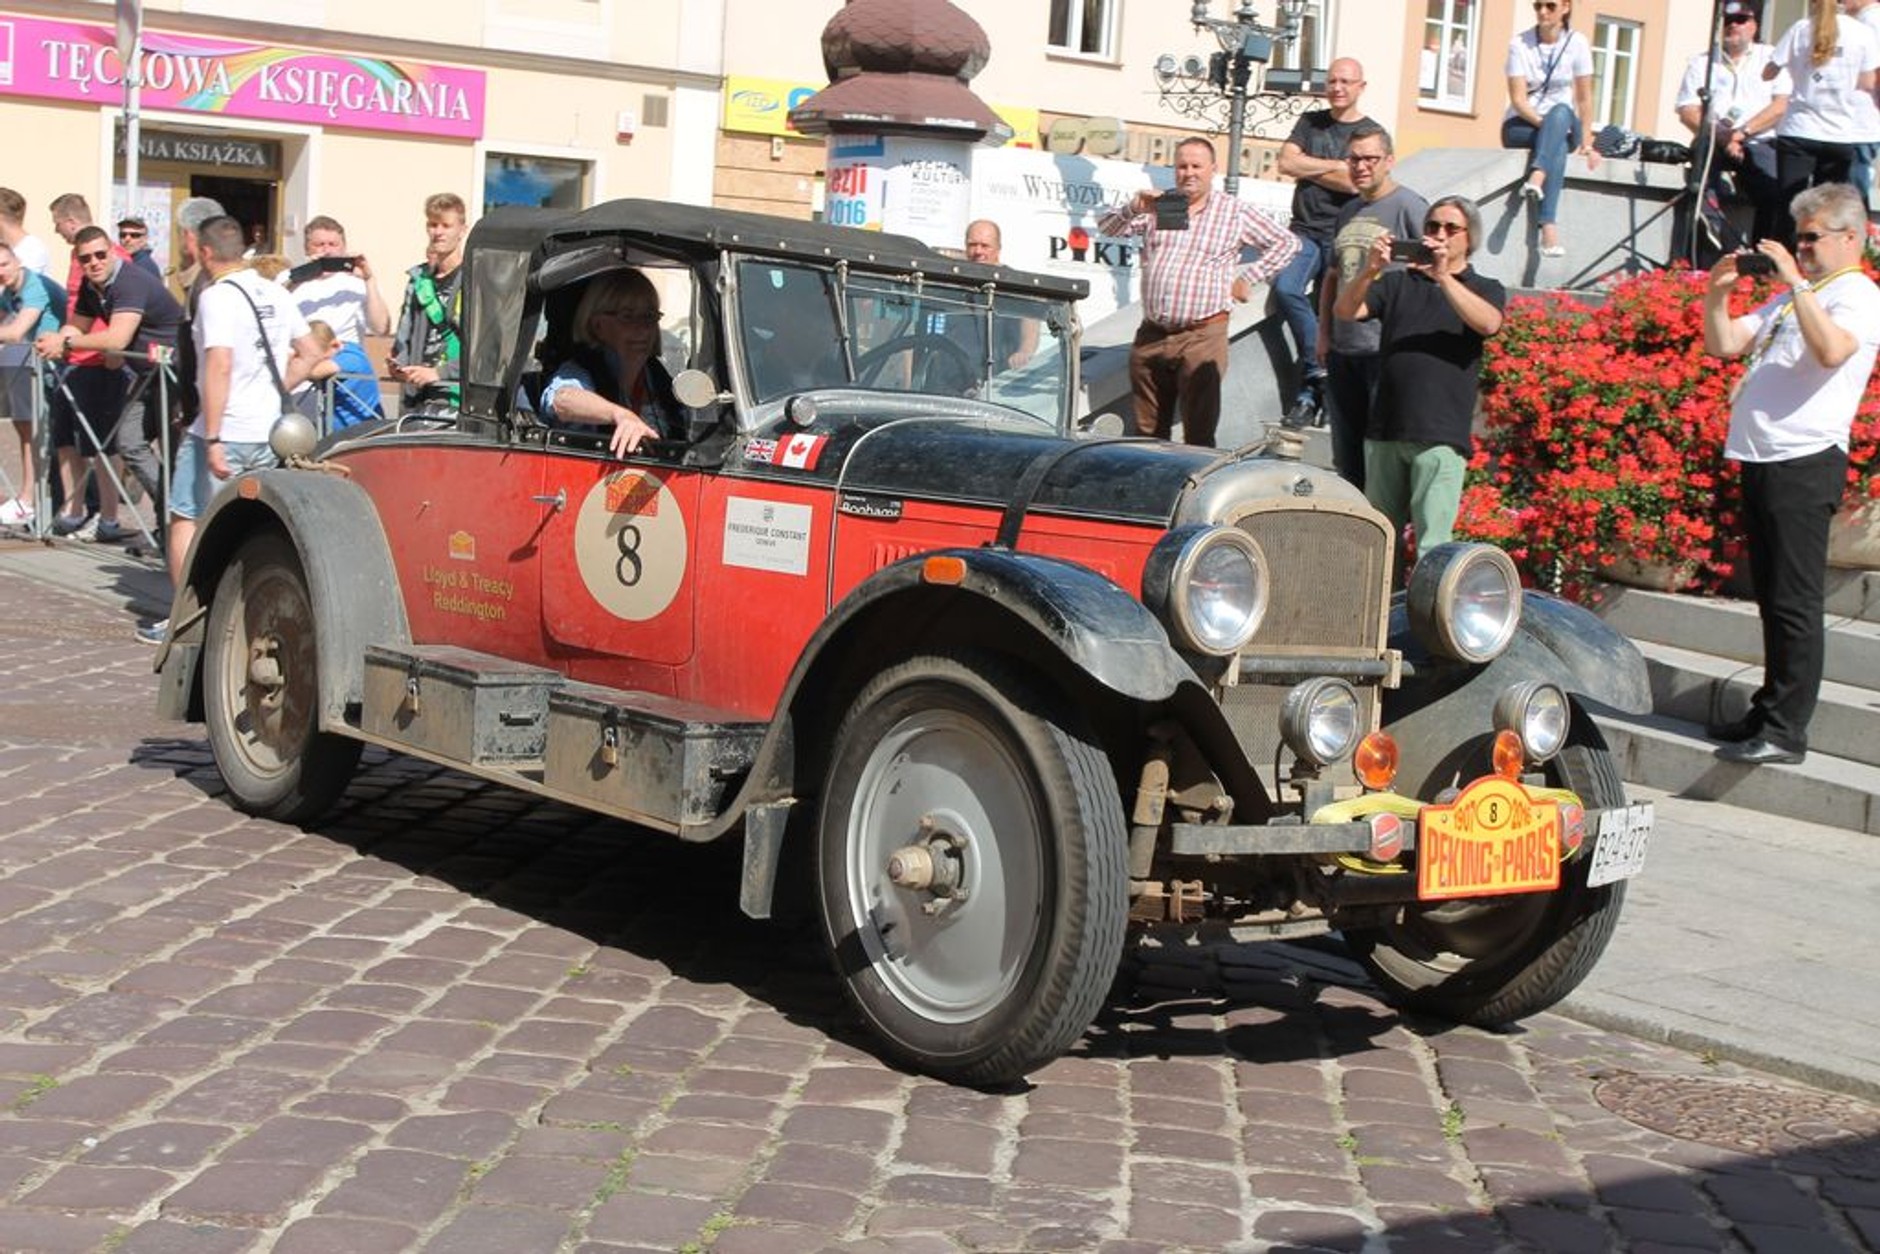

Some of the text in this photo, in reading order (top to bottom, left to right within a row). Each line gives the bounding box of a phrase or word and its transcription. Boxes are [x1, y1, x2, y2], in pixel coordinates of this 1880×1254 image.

[258, 65, 471, 121] KSIĘGARNIA
[174, 143, 266, 167] KSIĄŻKA
[827, 163, 868, 197] ezji
[615, 524, 642, 587] 8
[423, 561, 514, 602] Lloyd & Treacy
[433, 590, 506, 622] Reddington
[1489, 802, 1498, 823] 8
[1425, 826, 1494, 891] PEKING
[1501, 820, 1555, 884] PARIS
